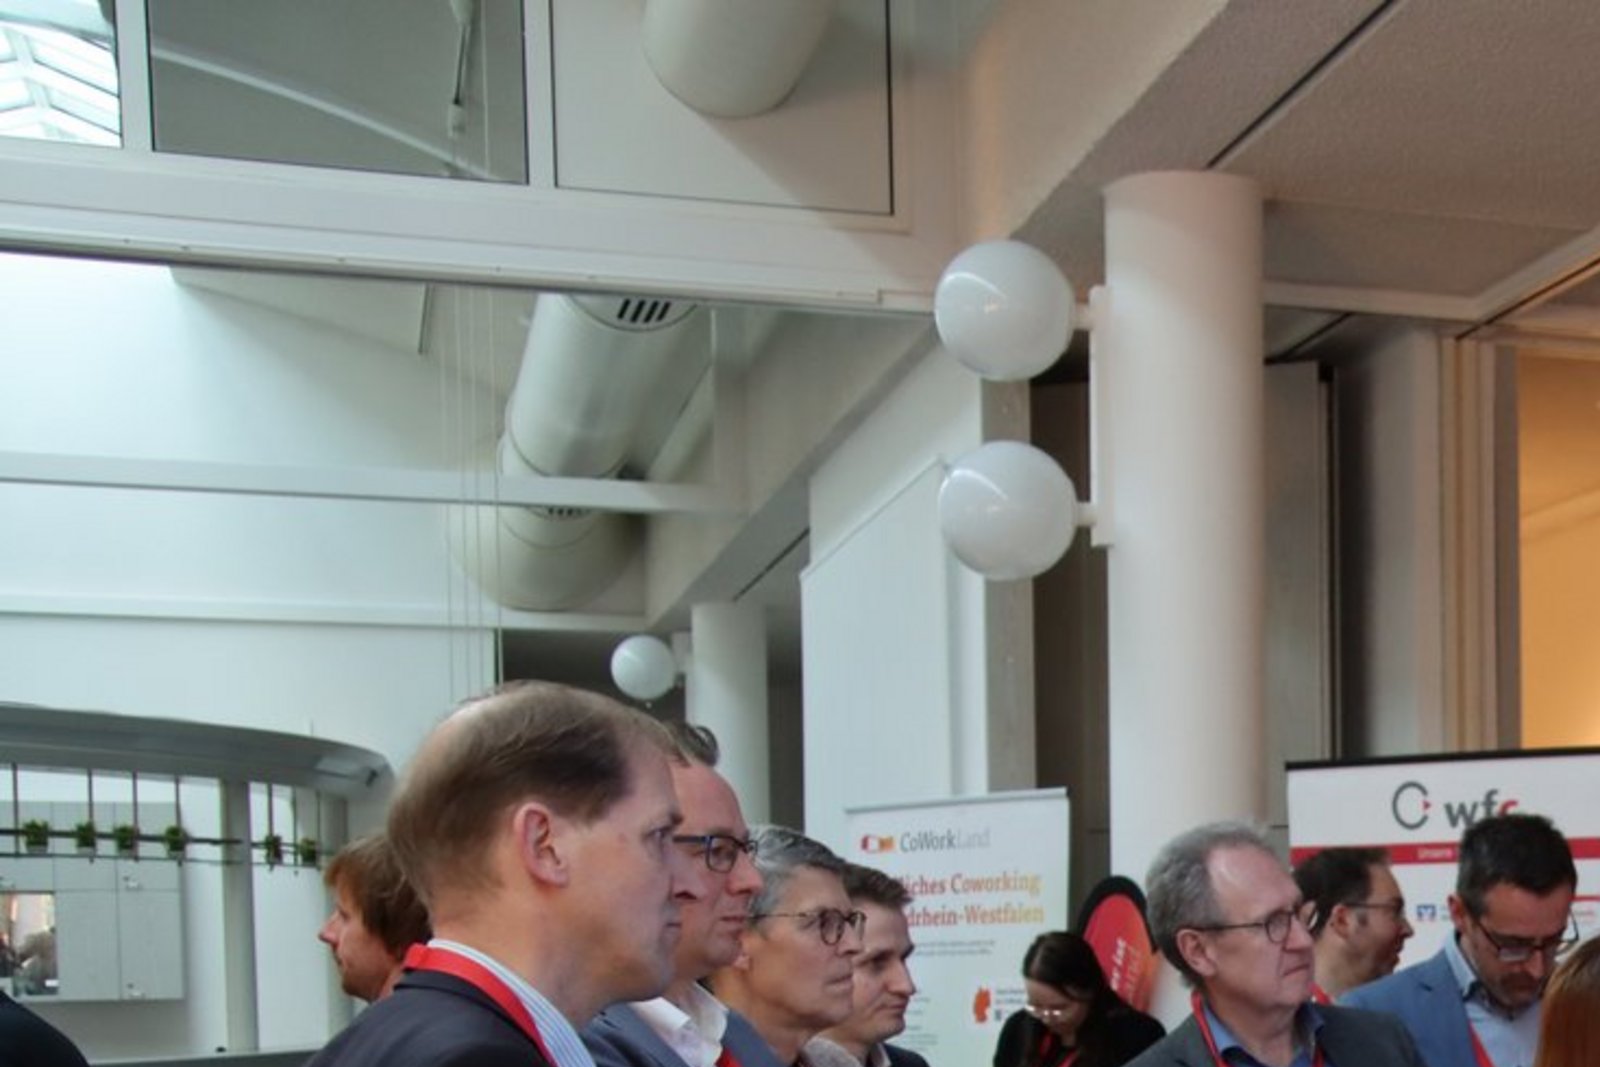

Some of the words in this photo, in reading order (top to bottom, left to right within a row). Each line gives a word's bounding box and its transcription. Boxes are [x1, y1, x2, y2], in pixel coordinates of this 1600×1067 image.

[900, 828, 991, 853] CoWorkLand
[951, 871, 1042, 897] Coworking
[908, 902, 1045, 926] drhein-Westfalen
